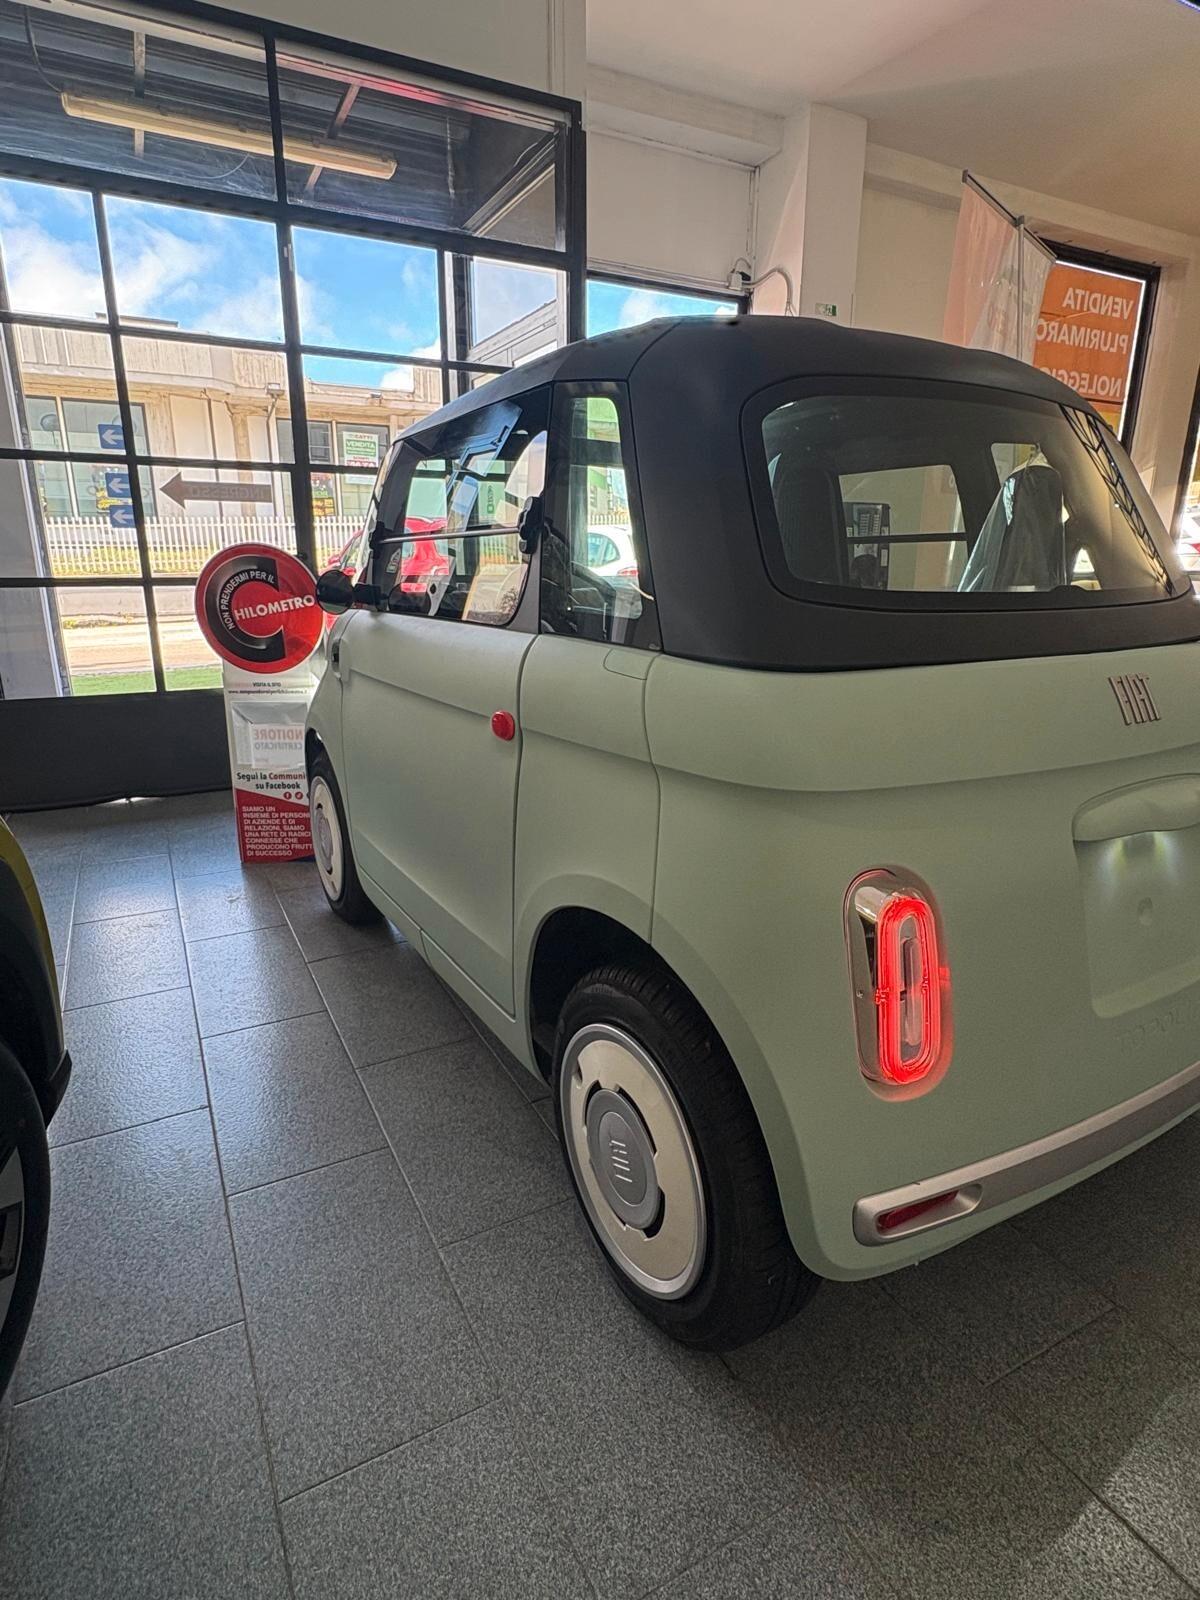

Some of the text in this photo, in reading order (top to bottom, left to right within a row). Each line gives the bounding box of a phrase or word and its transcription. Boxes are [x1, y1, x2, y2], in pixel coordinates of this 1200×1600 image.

[220, 571, 275, 630] NON PRENDERMI PER IL
[1108, 671, 1161, 726] FIAT
[237, 772, 305, 782] Segui la Communi
[266, 782, 301, 790] Facebook
